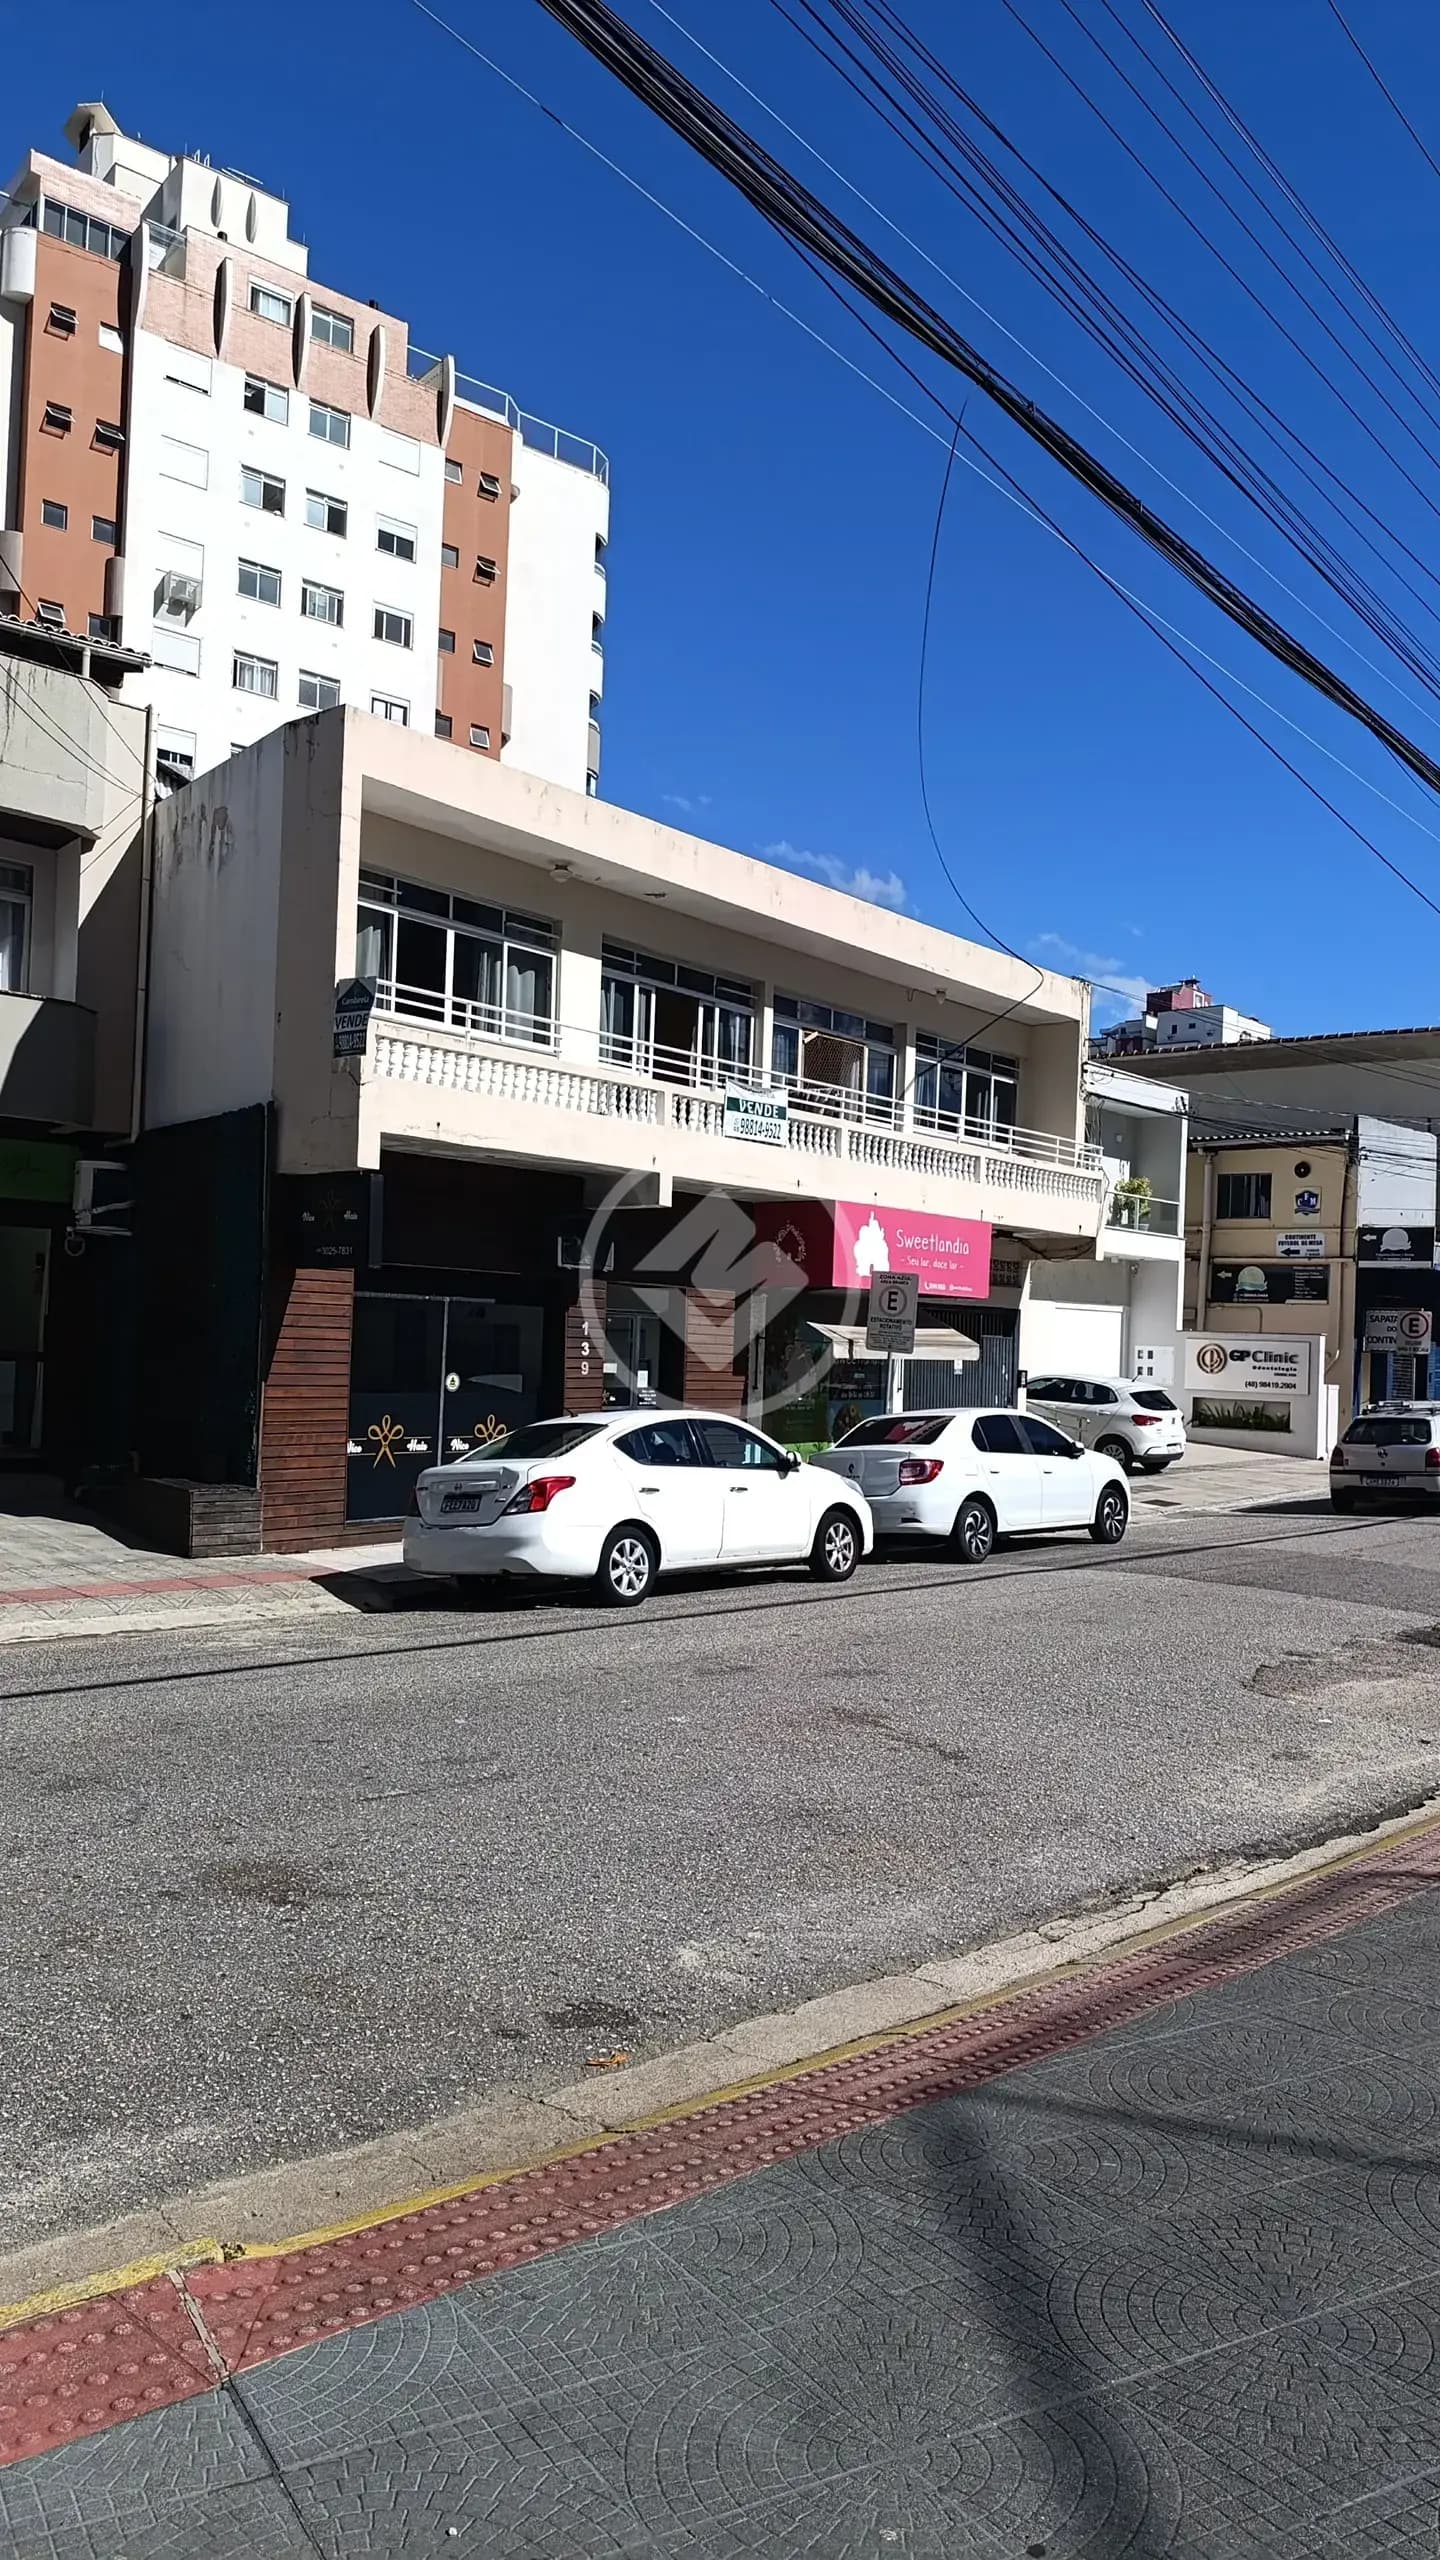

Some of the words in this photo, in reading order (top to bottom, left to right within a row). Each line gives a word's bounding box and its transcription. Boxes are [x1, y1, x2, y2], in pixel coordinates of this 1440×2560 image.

[335, 1014, 369, 1030] VENDE
[739, 1099, 780, 1119] VENDE
[740, 1117, 781, 1140] 98814-9522
[895, 1228, 970, 1255] Sweetlandia
[906, 1255, 919, 1266] Seu
[933, 1258, 948, 1270] doce
[949, 1260, 958, 1270] lar
[887, 1290, 899, 1311] E
[1408, 1317, 1420, 1334] E
